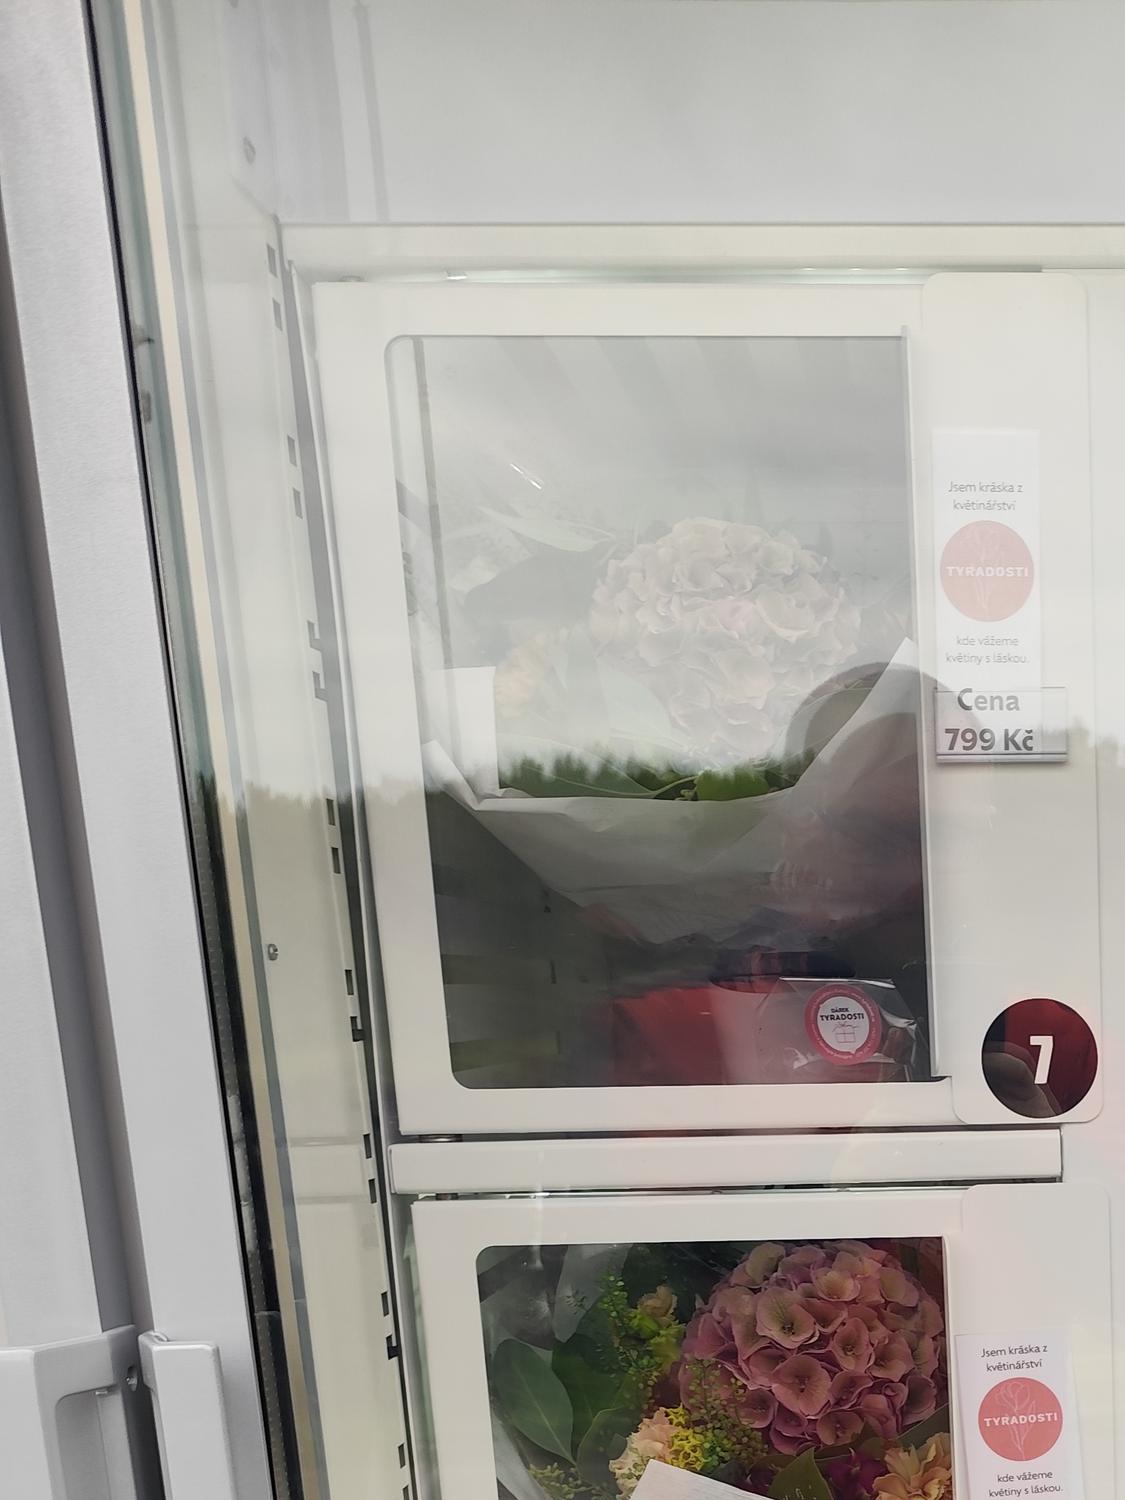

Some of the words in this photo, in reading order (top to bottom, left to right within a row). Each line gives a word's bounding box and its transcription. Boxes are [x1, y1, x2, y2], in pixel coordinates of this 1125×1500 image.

[948, 482, 976, 493] Jsem
[979, 482, 1014, 493] kráska
[1017, 485, 1024, 493] z
[946, 566, 1028, 577] TYRADOSTI
[956, 635, 976, 646] kde
[957, 687, 1020, 711] Cena
[944, 728, 996, 751] 799
[1004, 728, 1034, 751] Kč
[820, 1013, 865, 1021] TYRADOSTI
[1029, 1035, 1054, 1085] 7
[980, 1348, 1006, 1358] Jsem
[1008, 1345, 1040, 1355] kráska
[986, 1359, 1042, 1372] květinářství
[984, 1412, 1058, 1427] TYRADOSTI
[997, 1474, 1014, 1483] kde
[1016, 1471, 1053, 1481] vážeme
[989, 1488, 1022, 1498] květiny
